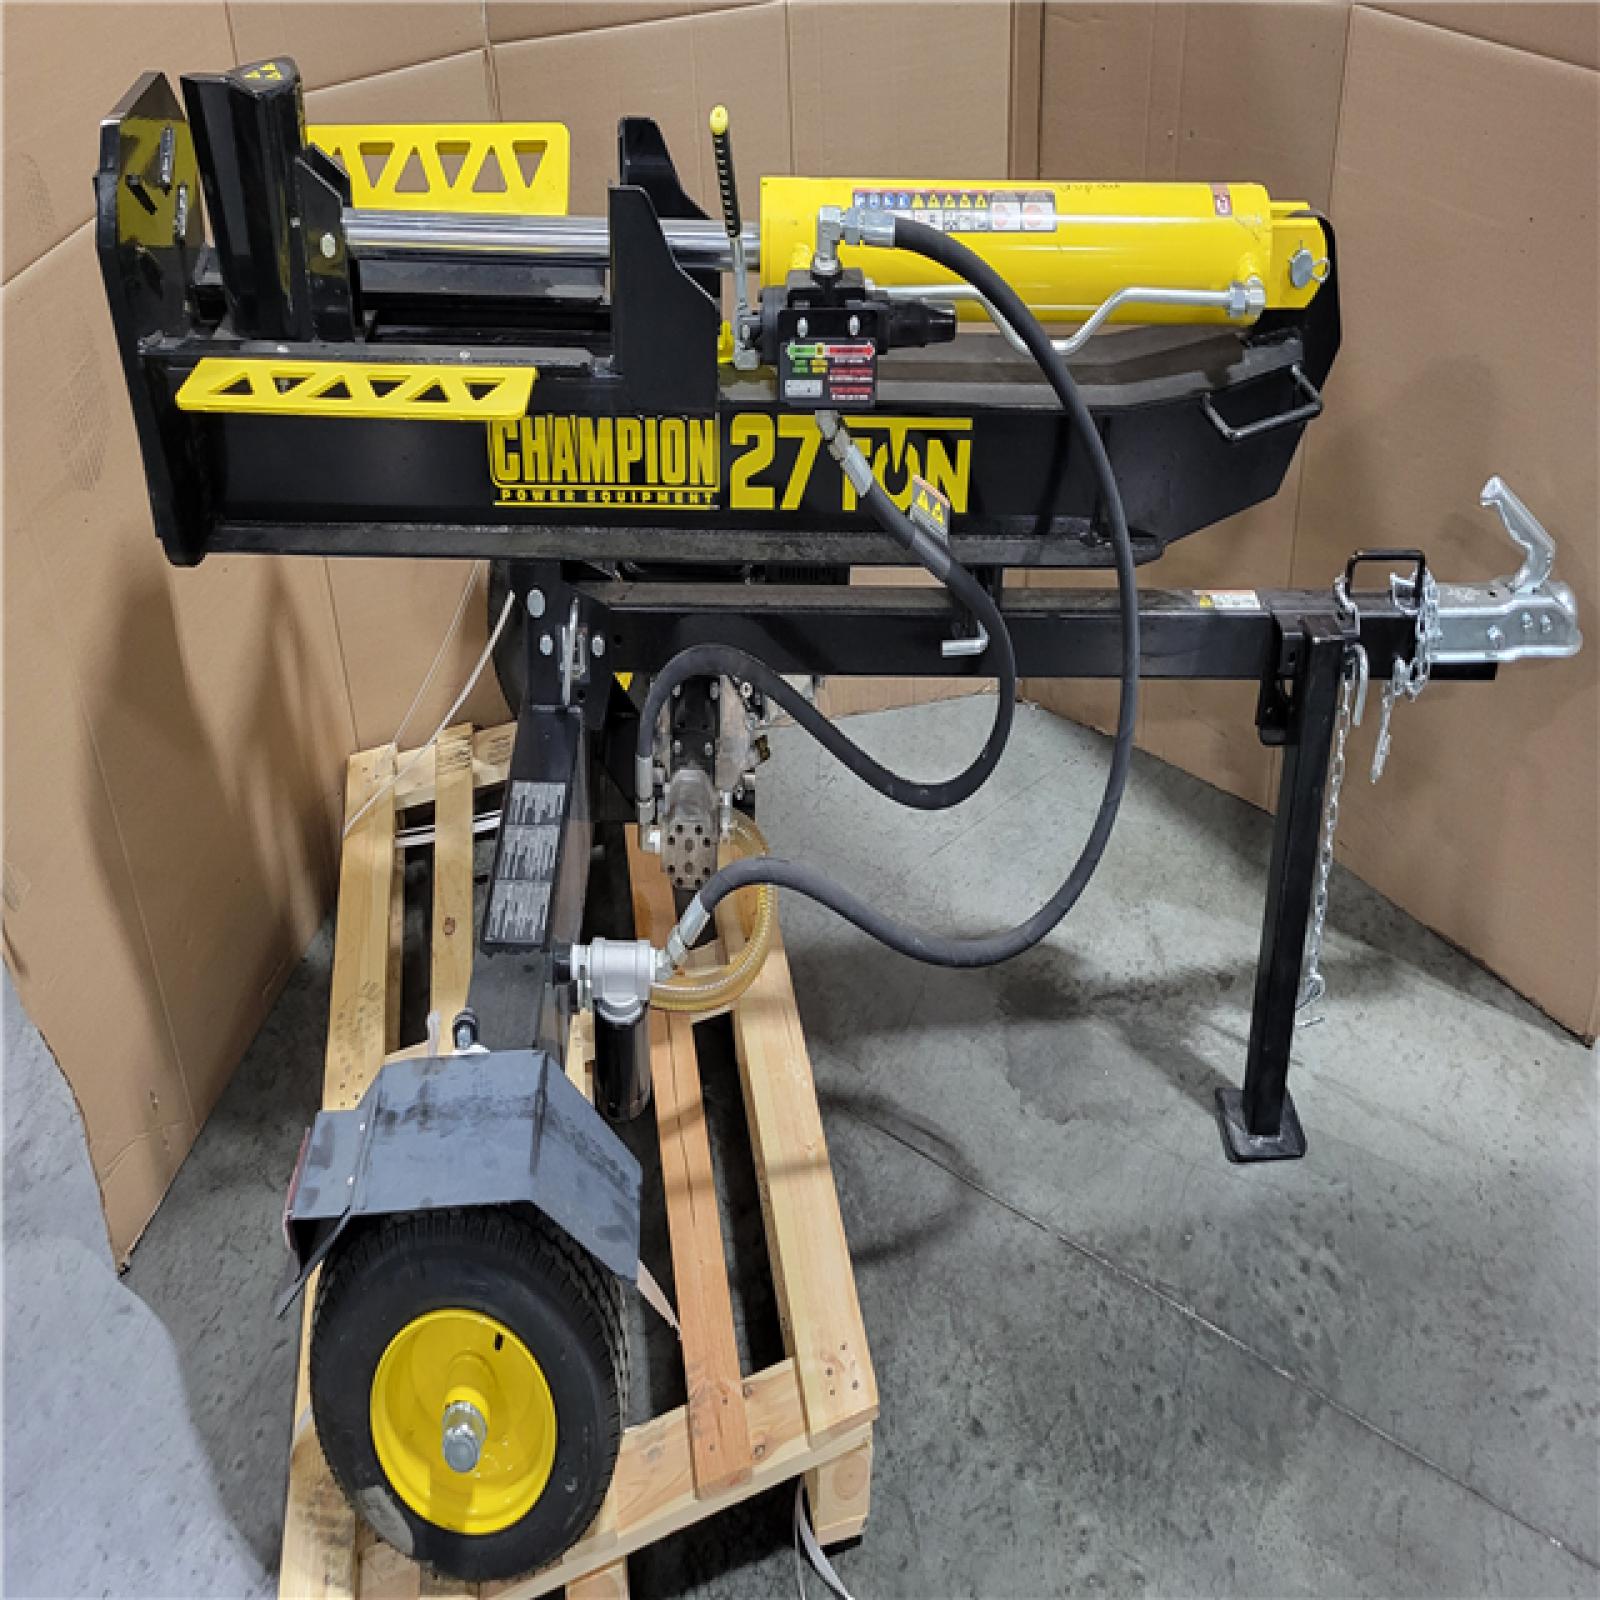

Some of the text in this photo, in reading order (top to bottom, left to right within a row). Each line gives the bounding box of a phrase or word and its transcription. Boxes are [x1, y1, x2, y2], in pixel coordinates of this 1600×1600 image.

[491, 416, 716, 484] CHAMPION
[730, 413, 822, 510] 27
[502, 489, 714, 504] POWER EQUIPMENT
